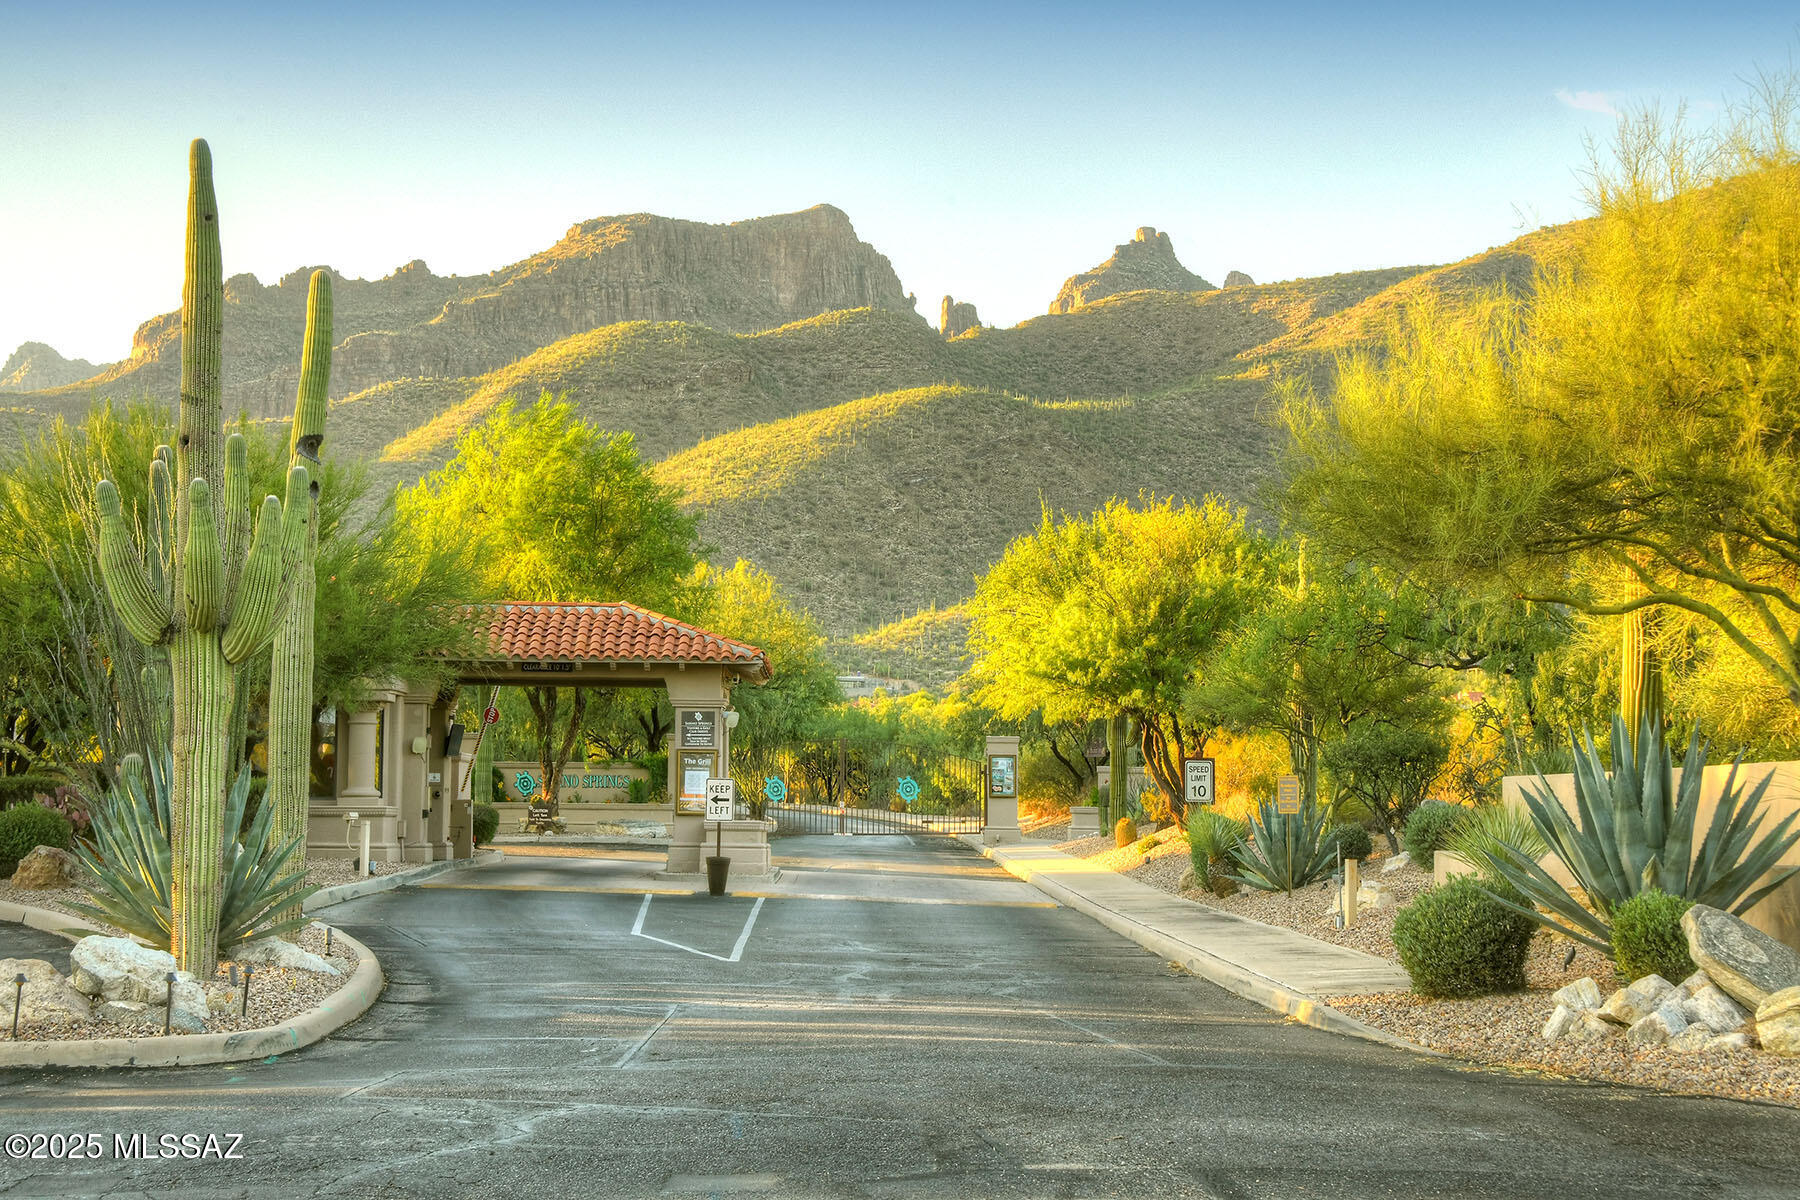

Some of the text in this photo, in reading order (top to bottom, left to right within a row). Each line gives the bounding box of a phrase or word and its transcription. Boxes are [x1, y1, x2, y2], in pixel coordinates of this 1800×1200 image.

[486, 707, 496, 723] STOP
[1188, 765, 1209, 773] SPEED
[582, 774, 631, 788] SPRINGS
[709, 785, 730, 793] KEEP
[1191, 785, 1206, 797] 10
[709, 806, 729, 814] LEFT
